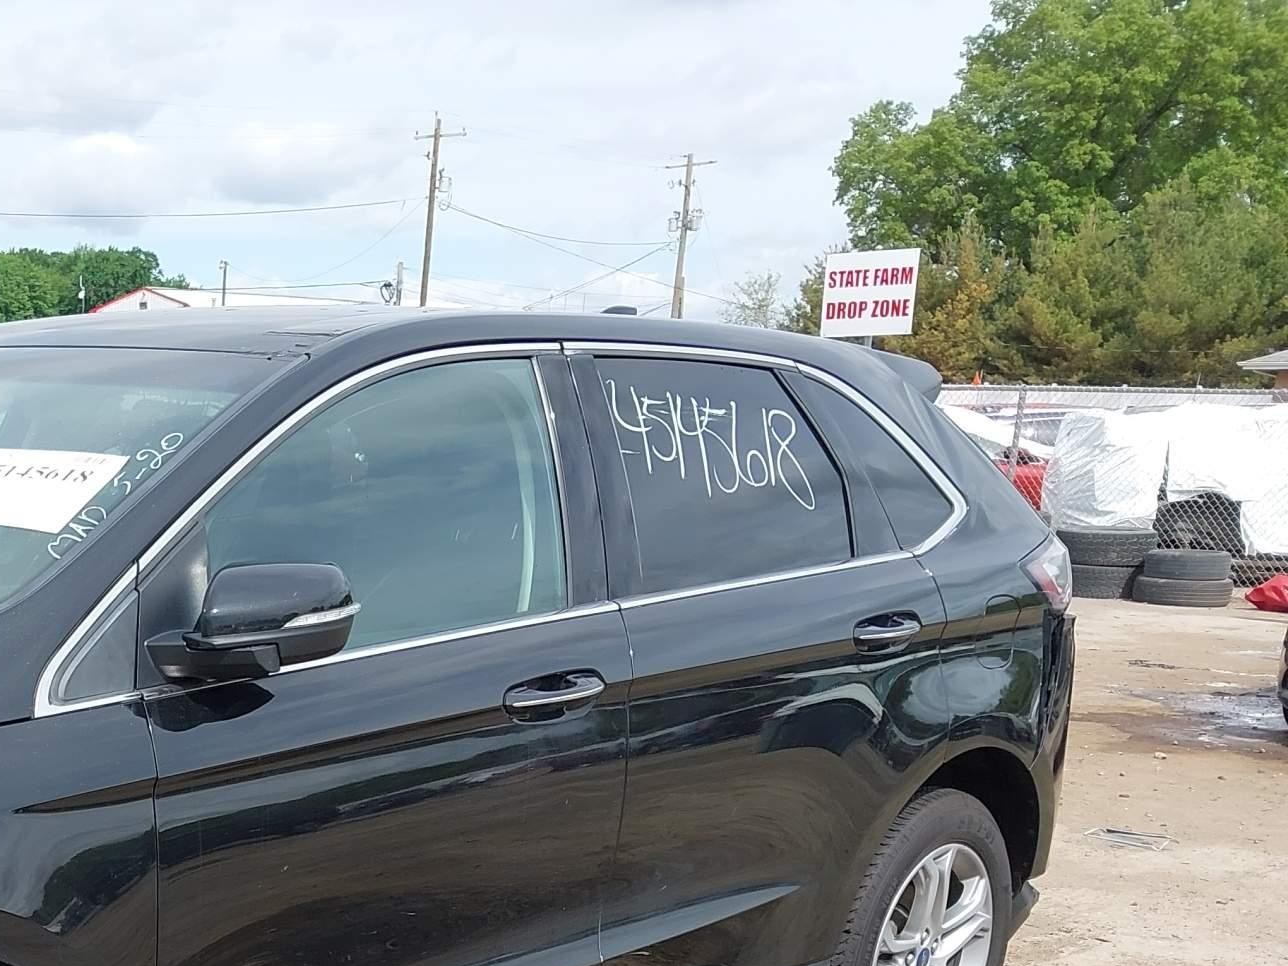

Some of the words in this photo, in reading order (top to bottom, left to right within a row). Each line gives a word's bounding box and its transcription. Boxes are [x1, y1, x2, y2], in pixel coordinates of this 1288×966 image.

[828, 269, 870, 289] STATE
[873, 266, 914, 287] FARM
[825, 301, 868, 320] DROP
[871, 299, 911, 318] ZONE
[112, 432, 184, 496] 5-20
[605, 378, 816, 511] 45145618
